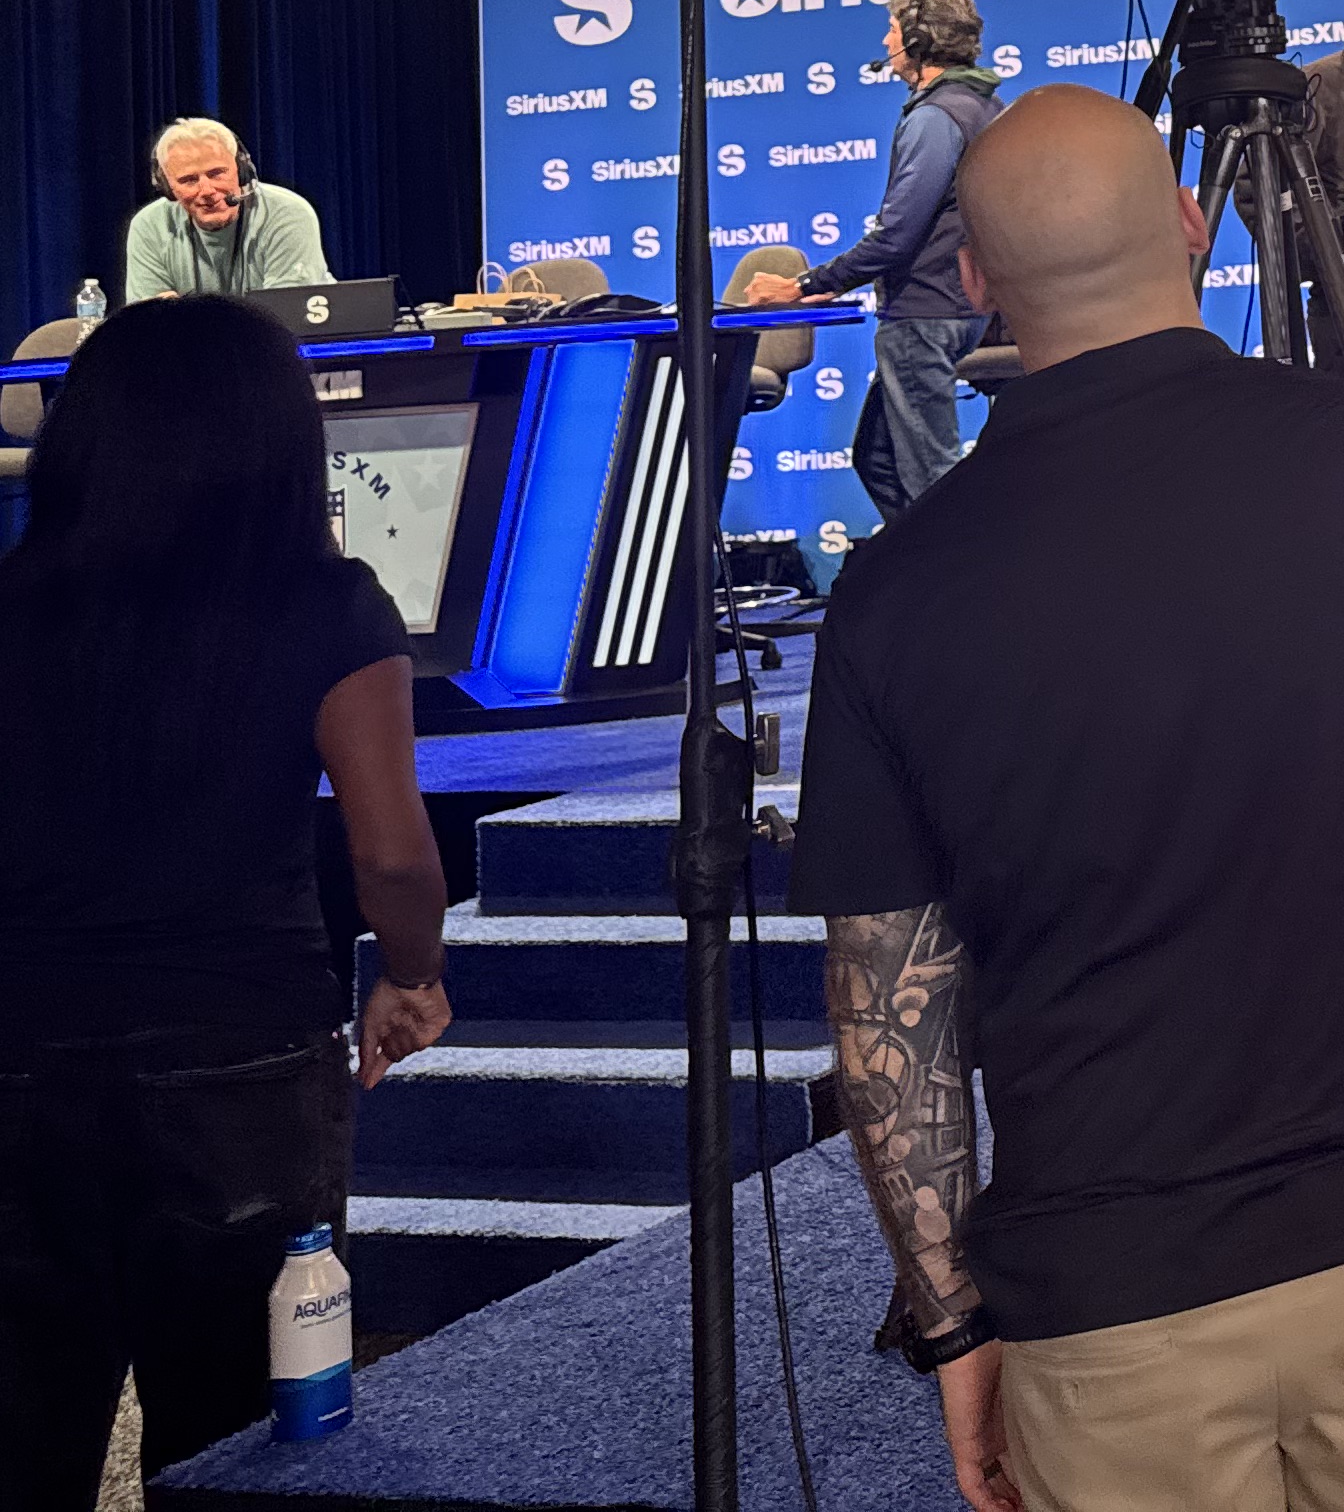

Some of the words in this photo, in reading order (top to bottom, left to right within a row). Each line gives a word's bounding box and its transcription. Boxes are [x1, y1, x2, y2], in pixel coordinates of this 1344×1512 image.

[507, 88, 608, 115] SiriusXM
[769, 138, 877, 167] SiriusXM
[509, 234, 610, 263] SiriusXM
